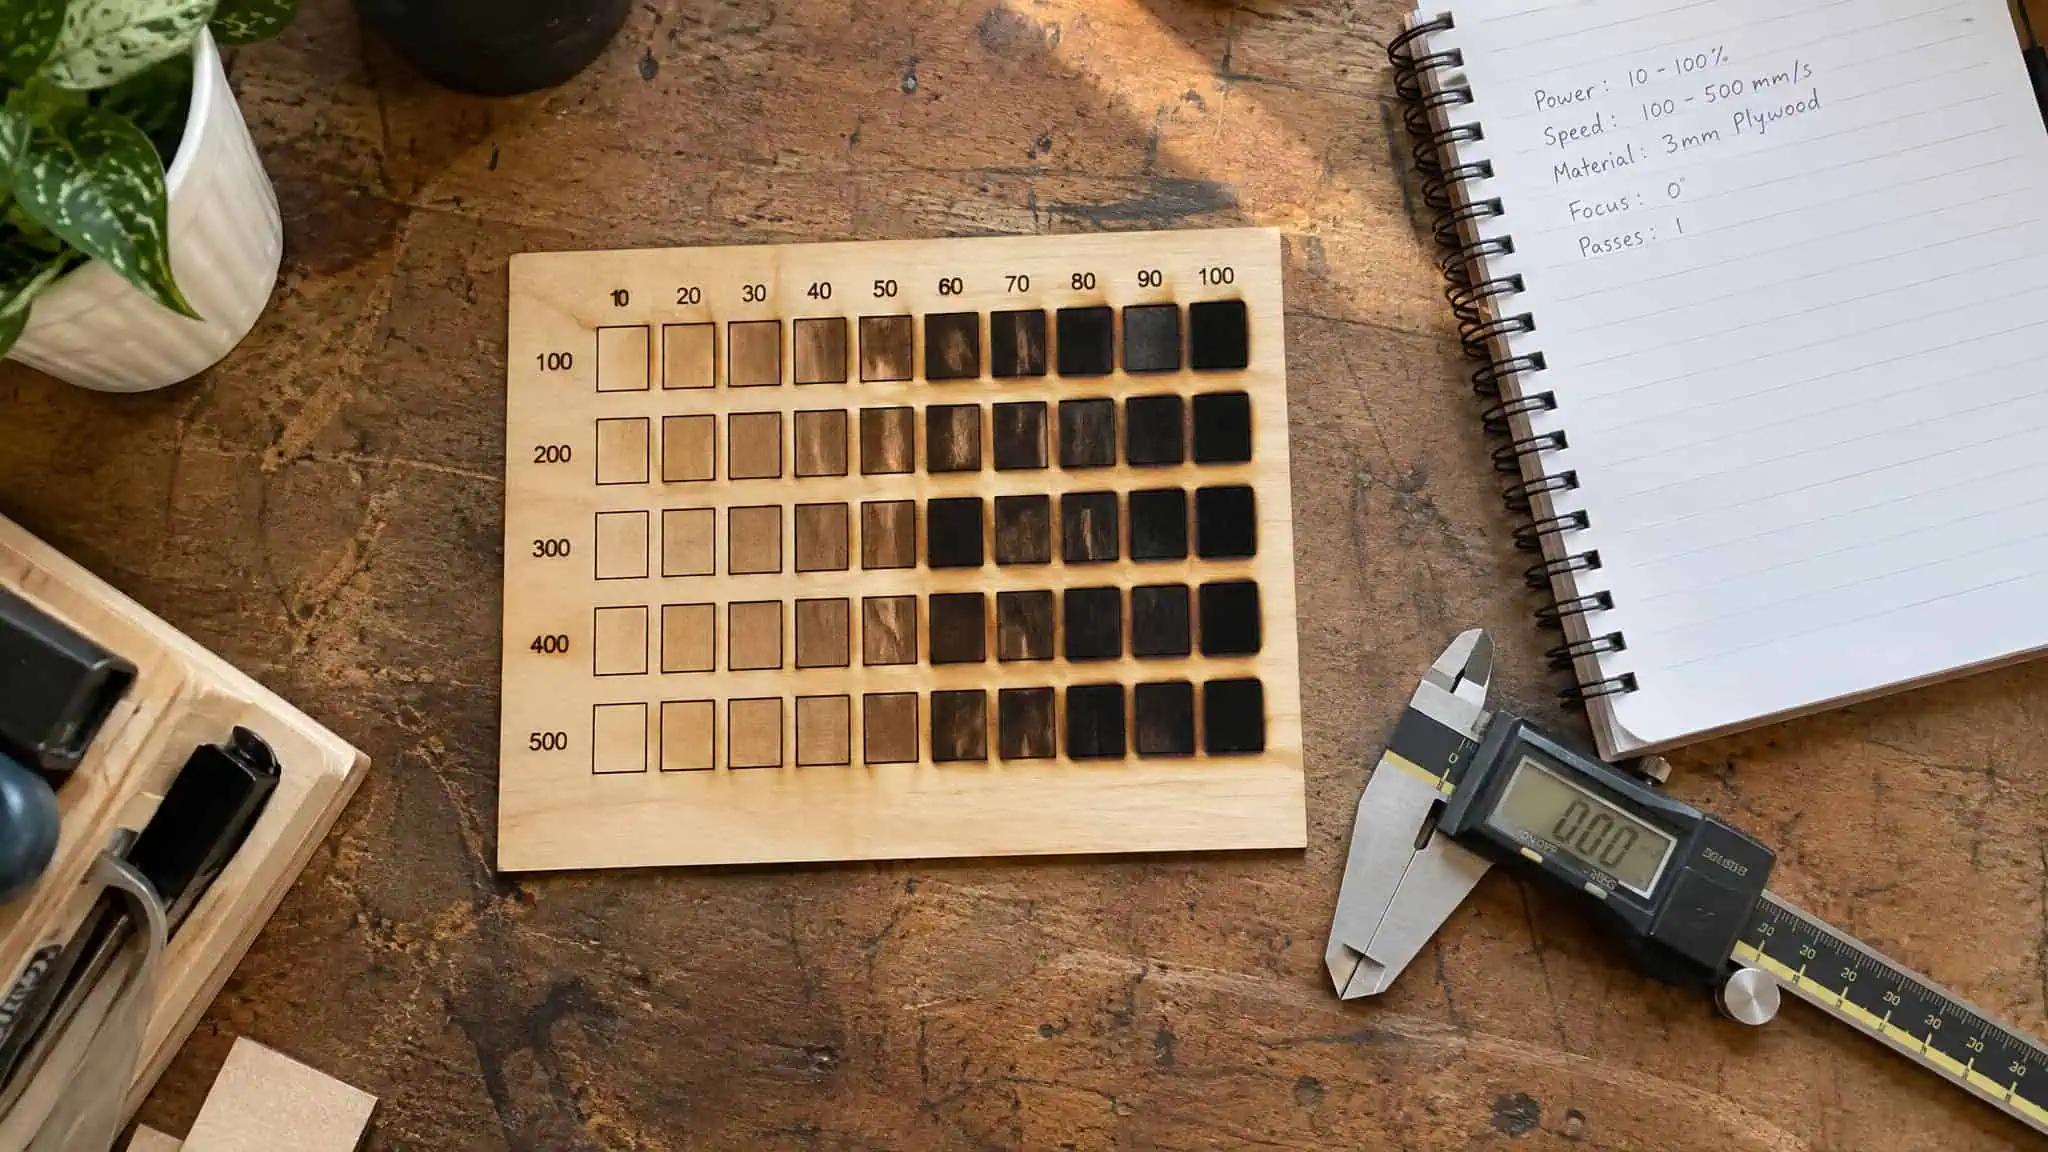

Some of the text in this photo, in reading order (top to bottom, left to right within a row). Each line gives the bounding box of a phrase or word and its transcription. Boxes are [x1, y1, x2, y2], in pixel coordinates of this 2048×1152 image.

[1534, 79, 1609, 112] Power:
[1628, 68, 1648, 88] 10
[1674, 45, 1729, 75] 100%
[1543, 111, 1617, 149] Speed:
[1642, 99, 1675, 121] 100
[1704, 79, 1744, 104] 500
[1751, 59, 1813, 92] mm/s
[1553, 143, 1648, 185] Material:
[1732, 87, 1821, 135] Plywood
[1568, 192, 1643, 222] Focus:
[1578, 226, 1656, 258] Passes:
[609, 266, 1235, 308] 10 20 30 40 50 60 70 80 90 100
[536, 351, 573, 372] 100
[533, 444, 572, 465] 200
[531, 538, 571, 558] 300
[529, 633, 570, 655] 400
[528, 731, 568, 752] 500
